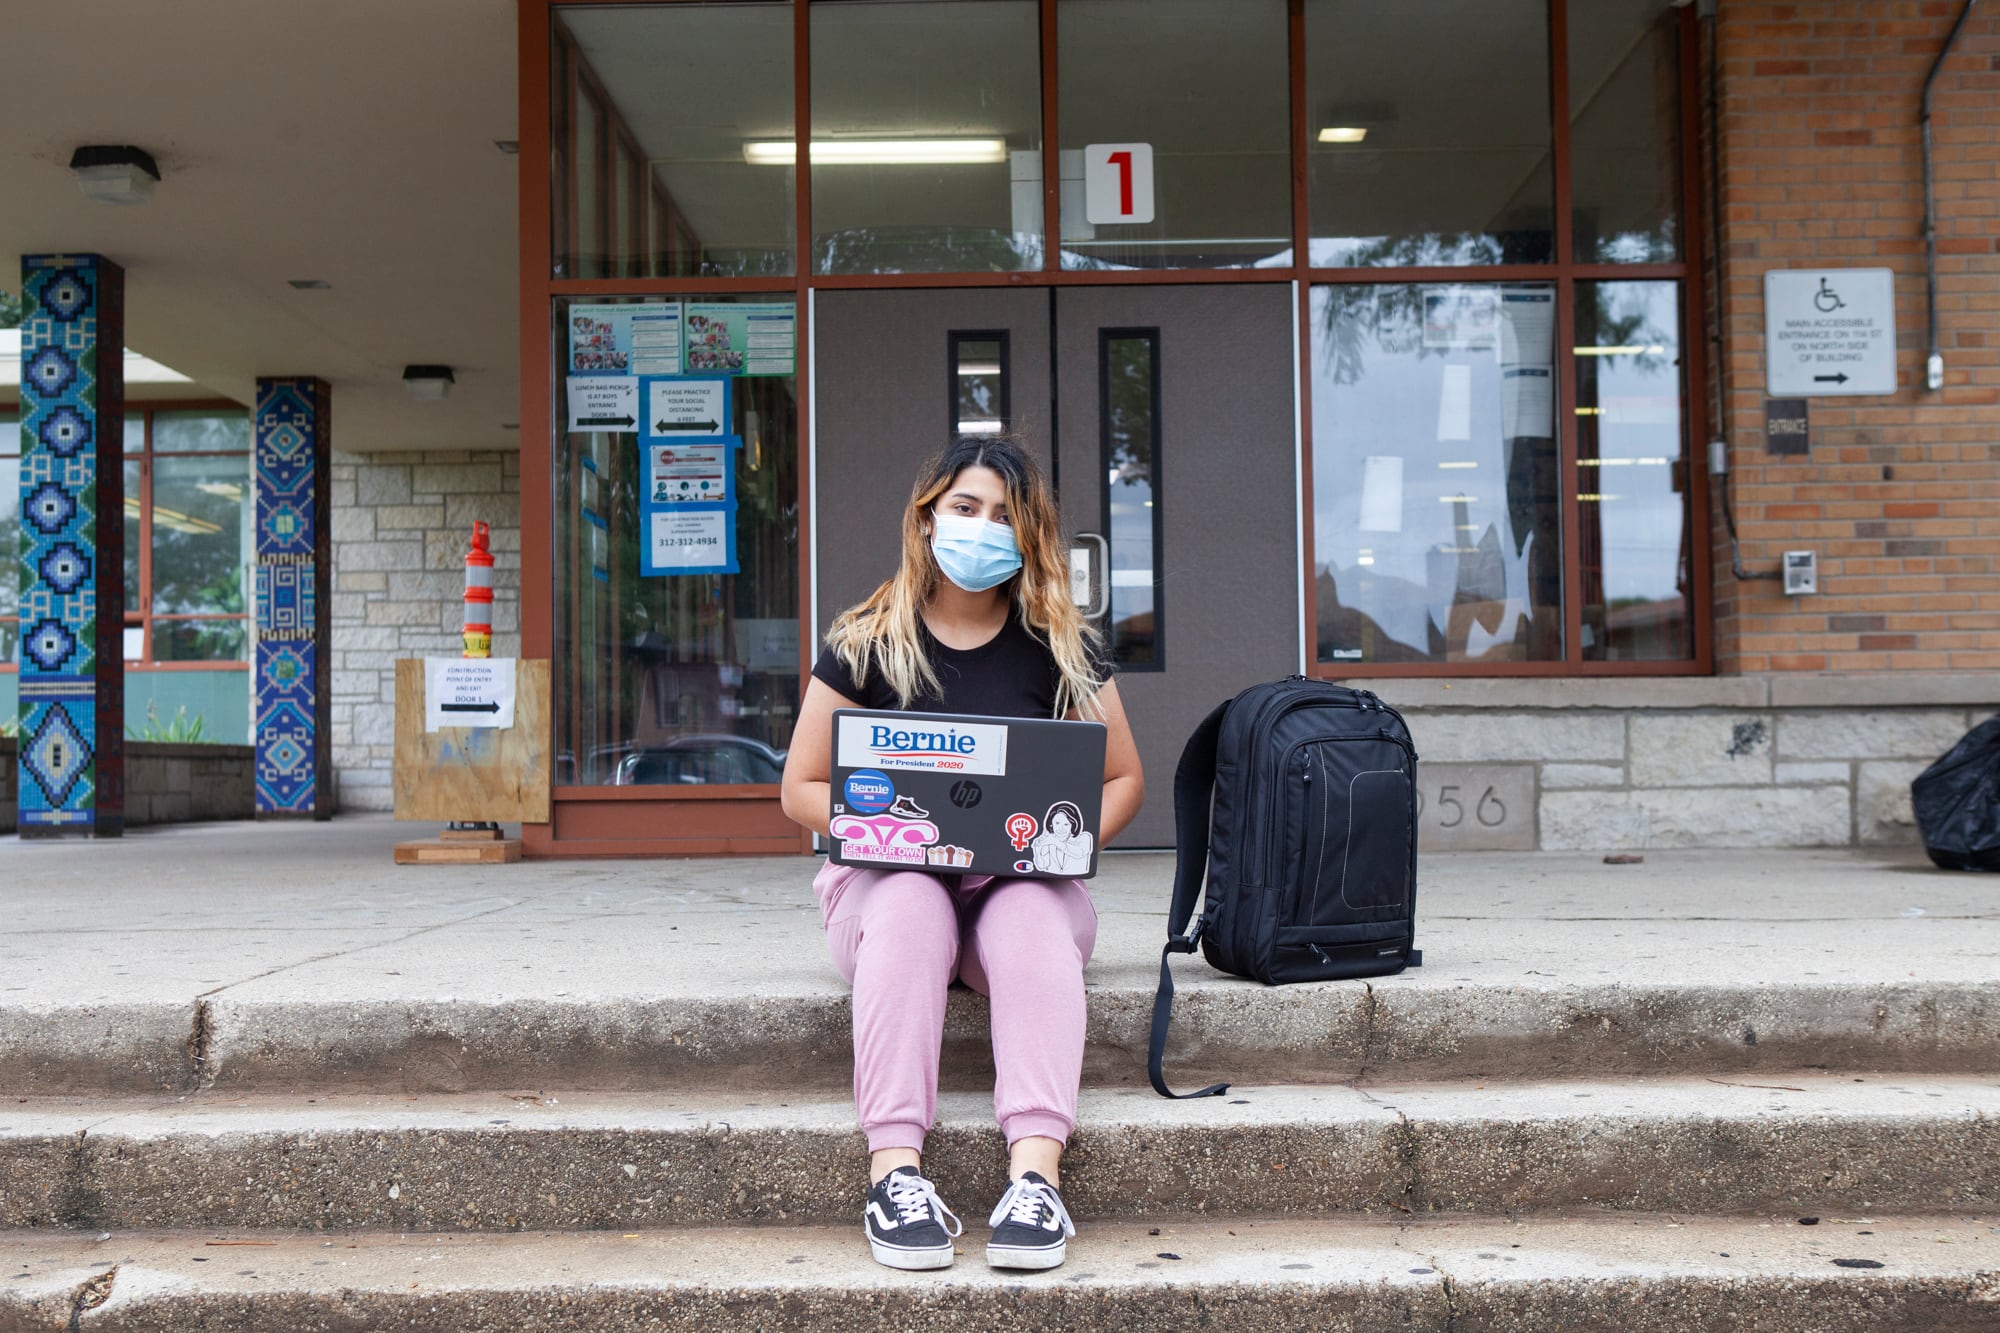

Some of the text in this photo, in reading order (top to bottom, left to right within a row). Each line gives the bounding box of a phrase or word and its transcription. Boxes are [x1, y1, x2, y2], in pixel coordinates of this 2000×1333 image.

[1107, 151, 1134, 216] 1
[1785, 318, 1873, 328] MAIN ACCESSIBLE
[1778, 330, 1830, 340] ENTRANCE
[1834, 330, 1850, 338] ON
[1792, 342, 1868, 351] ON NORTH SIDE
[1799, 353, 1862, 362] OF BUILDING
[1769, 418, 1806, 435] ENTRANCE
[659, 537, 718, 546] 312-312-4934
[870, 725, 976, 754] Bernie
[896, 759, 934, 768] President
[936, 760, 964, 770] 2020
[850, 782, 890, 794] Bernie
[953, 780, 979, 808] hp
[845, 844, 923, 858] GET YOUR OWN
